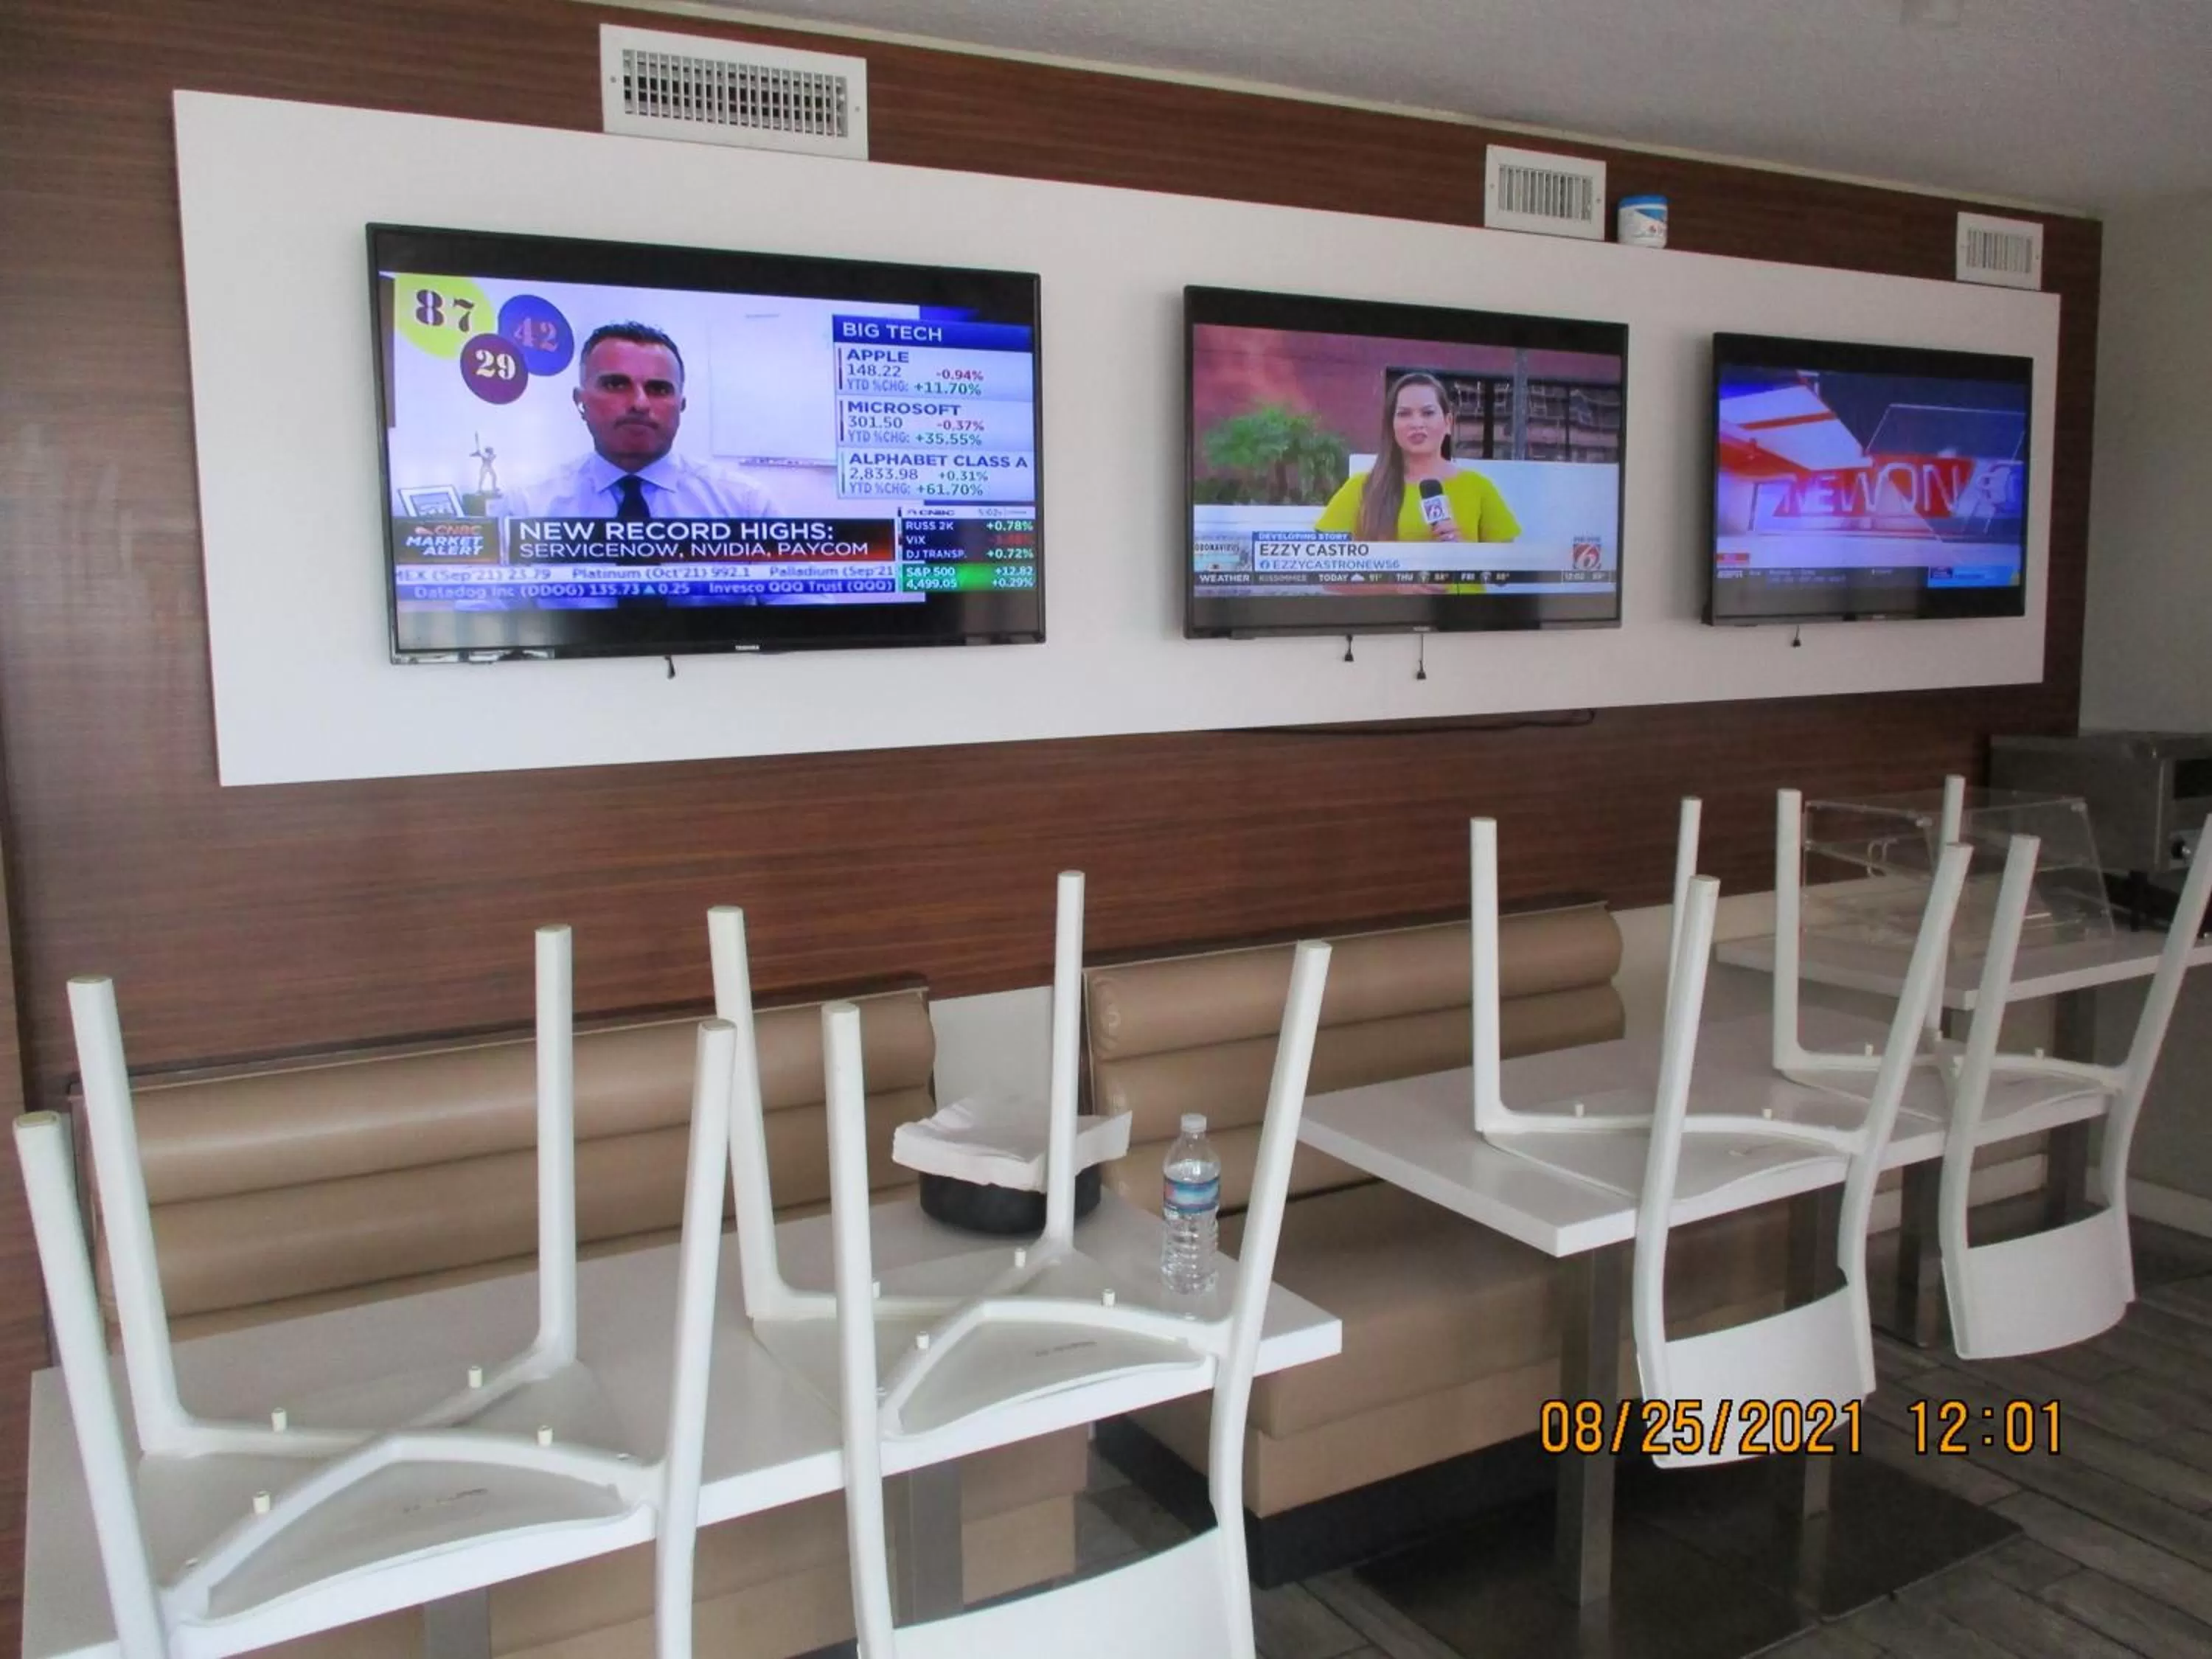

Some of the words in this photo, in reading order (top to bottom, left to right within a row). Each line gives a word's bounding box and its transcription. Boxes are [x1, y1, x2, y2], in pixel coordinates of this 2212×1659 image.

[415, 289, 475, 333] 87
[514, 318, 558, 352] 42
[843, 322, 880, 338] BIG
[886, 324, 942, 341] TECH
[847, 348, 909, 363] APPLE
[475, 349, 515, 380] 29
[847, 364, 901, 378] 148.22
[936, 369, 984, 381] -0.94%
[847, 378, 869, 392] YTD
[914, 383, 982, 395] +11.70%
[848, 400, 961, 416] MICROSOFT
[848, 416, 903, 429] 301.50
[937, 420, 985, 432] -0.37%
[848, 430, 871, 443] YTD
[915, 433, 983, 445] +35.55%
[849, 453, 947, 467] ALPHABET
[953, 455, 1011, 468] CLASS
[1015, 456, 1029, 469] A
[849, 467, 919, 481] 2,833.98
[939, 470, 989, 481] +0.31%
[849, 482, 872, 494] YTD
[917, 483, 984, 496] +61.70%
[519, 521, 595, 540] NEW
[605, 521, 731, 540] RECORD
[740, 522, 834, 540] HIGHS:
[905, 521, 937, 531] RUSS
[939, 521, 954, 531] 2K
[986, 521, 1034, 532] +0.78%
[406, 536, 484, 547] MARKET
[906, 535, 926, 545] VIX
[422, 546, 484, 556] ALERT
[519, 542, 684, 558] SERVICENOW,
[691, 542, 772, 558] NVIDIA,
[778, 542, 869, 557] PAYCOM
[905, 549, 920, 559] DJ
[986, 549, 1034, 560] +0.72%
[1260, 543, 1301, 557] EZZY
[1306, 543, 1370, 557] CASTRO
[571, 567, 641, 580] Platinum
[769, 566, 839, 577] Palladium
[905, 566, 931, 578] S&P
[933, 567, 956, 577] 500
[1199, 574, 1251, 582] WEATHER
[1318, 574, 1349, 582] TODAY
[589, 582, 640, 597] 135.73
[658, 582, 691, 595] 0.25
[709, 582, 765, 595] Invesco
[810, 580, 843, 593] Trust
